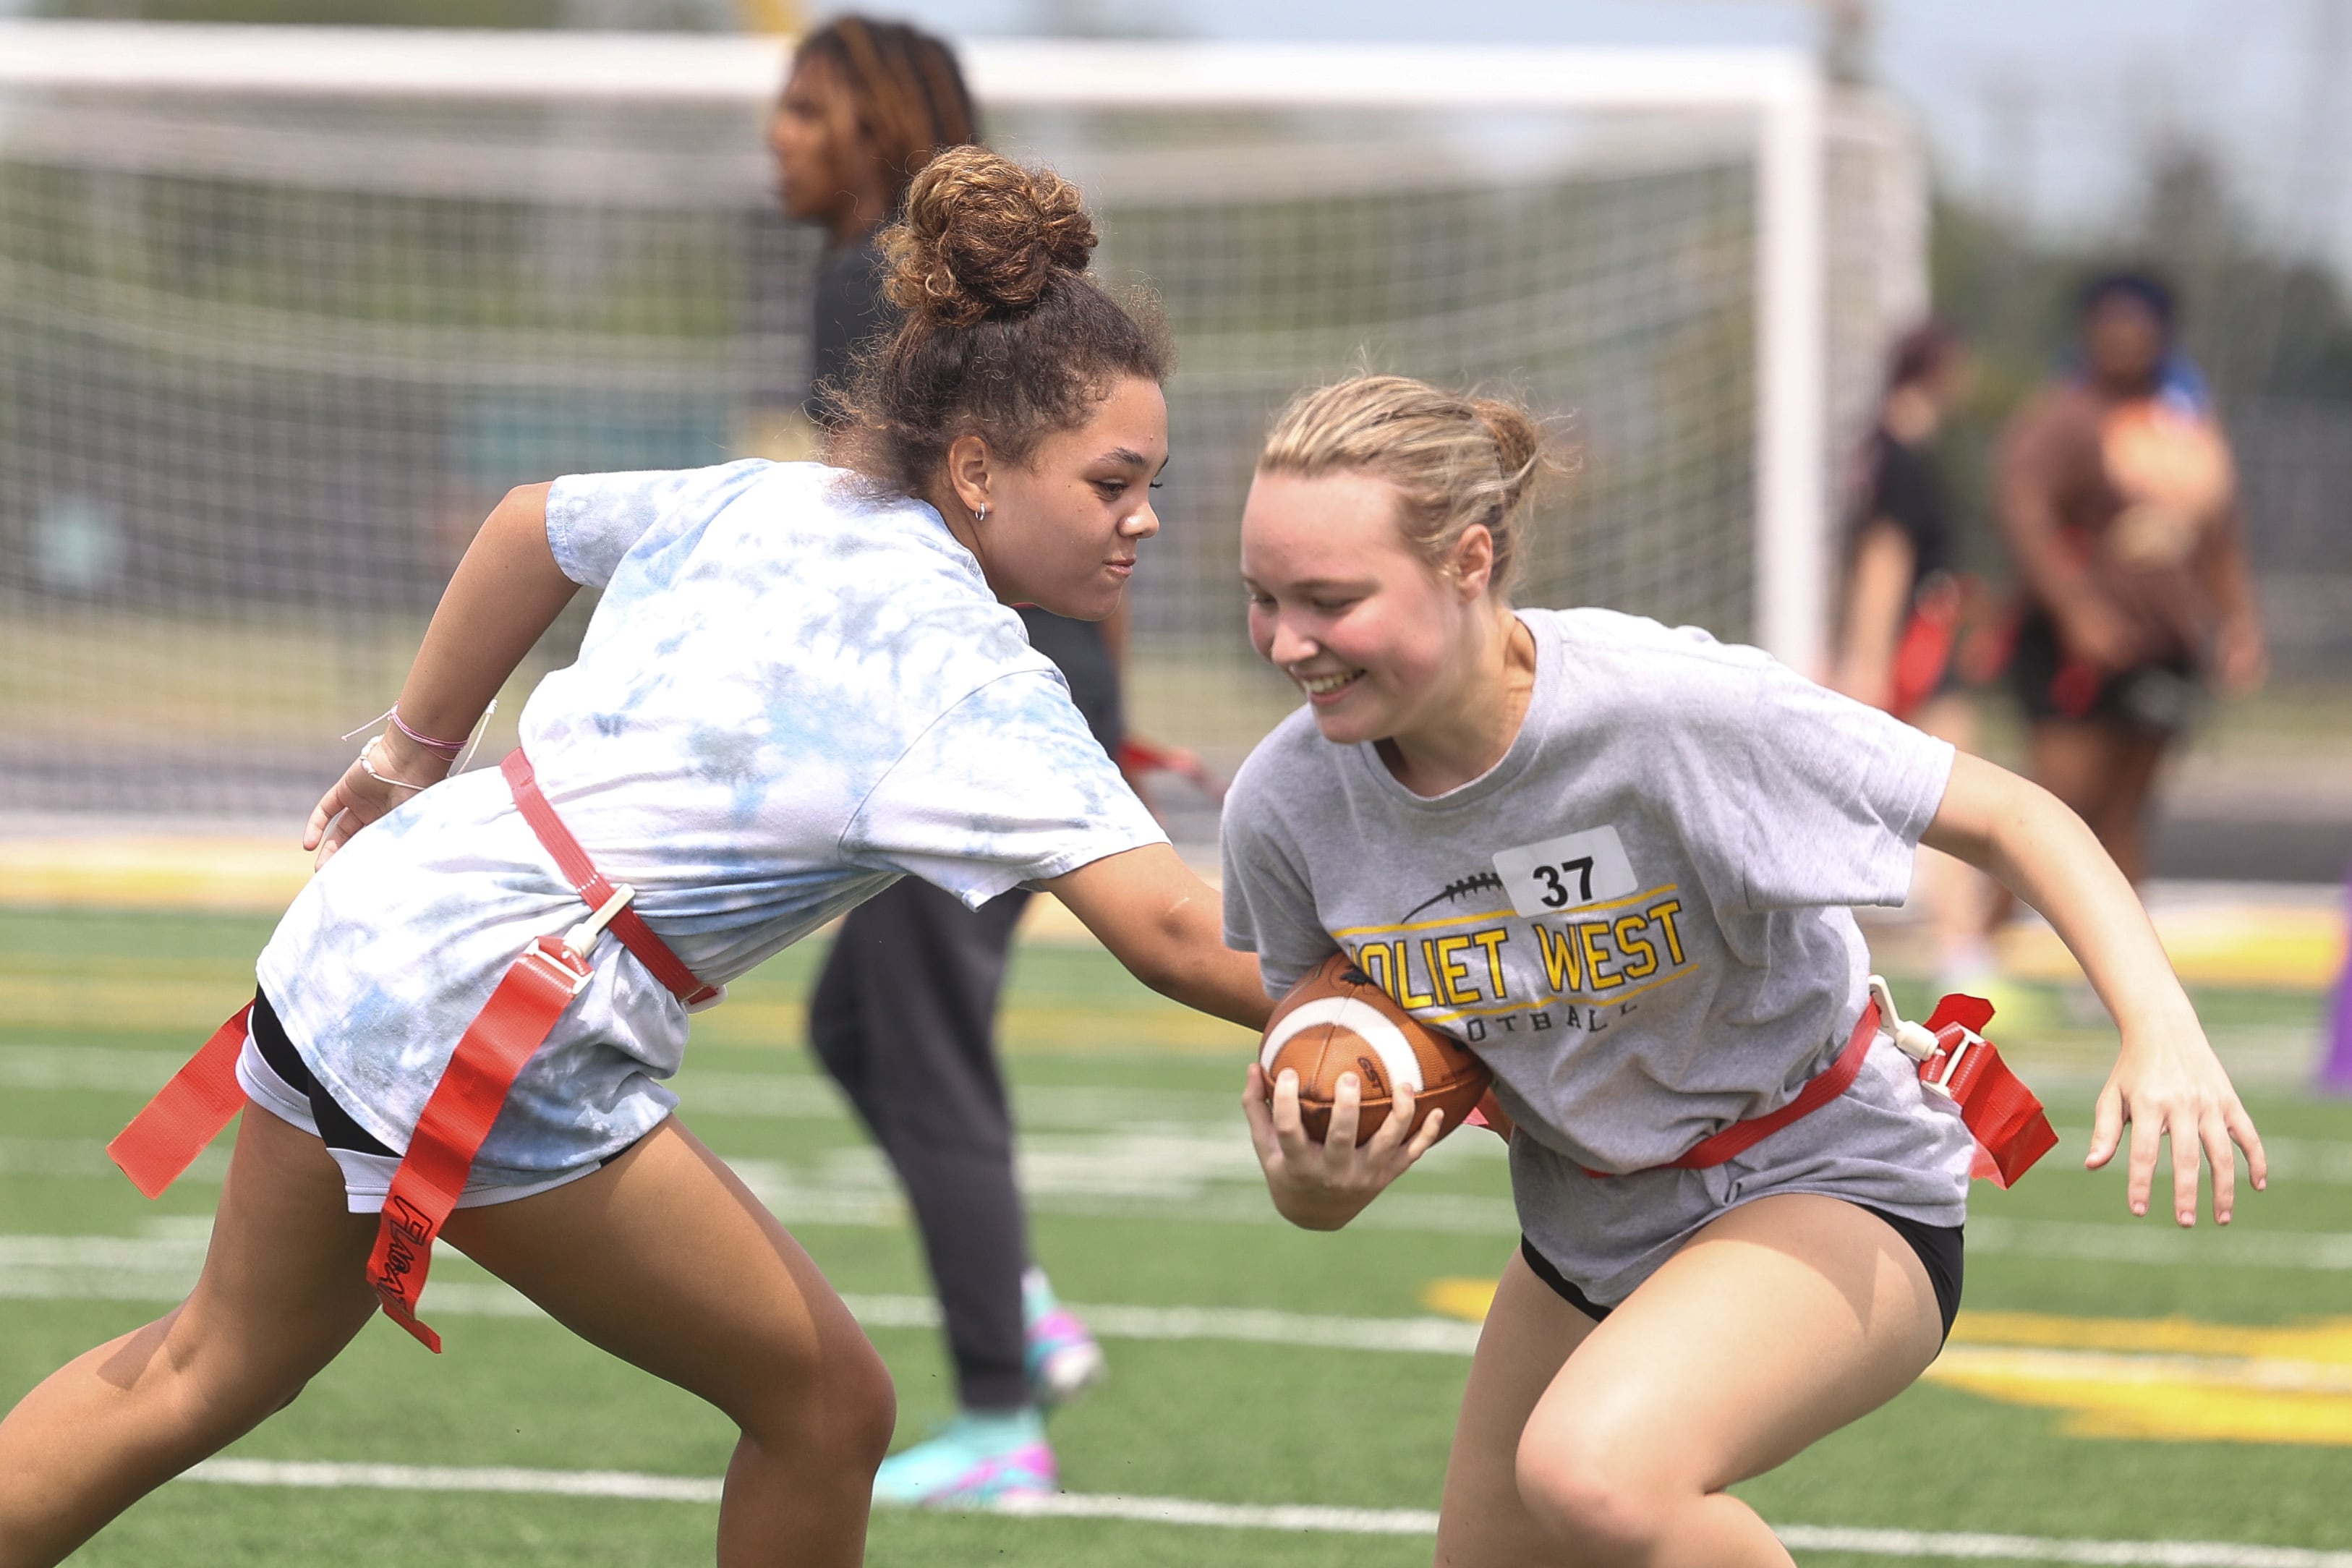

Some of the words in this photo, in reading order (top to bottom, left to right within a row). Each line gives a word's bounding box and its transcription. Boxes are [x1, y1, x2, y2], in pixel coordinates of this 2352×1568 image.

[1532, 856, 1594, 908] 37
[1531, 899, 1686, 992] WEST
[1442, 1002, 1638, 1042] OTBALL
